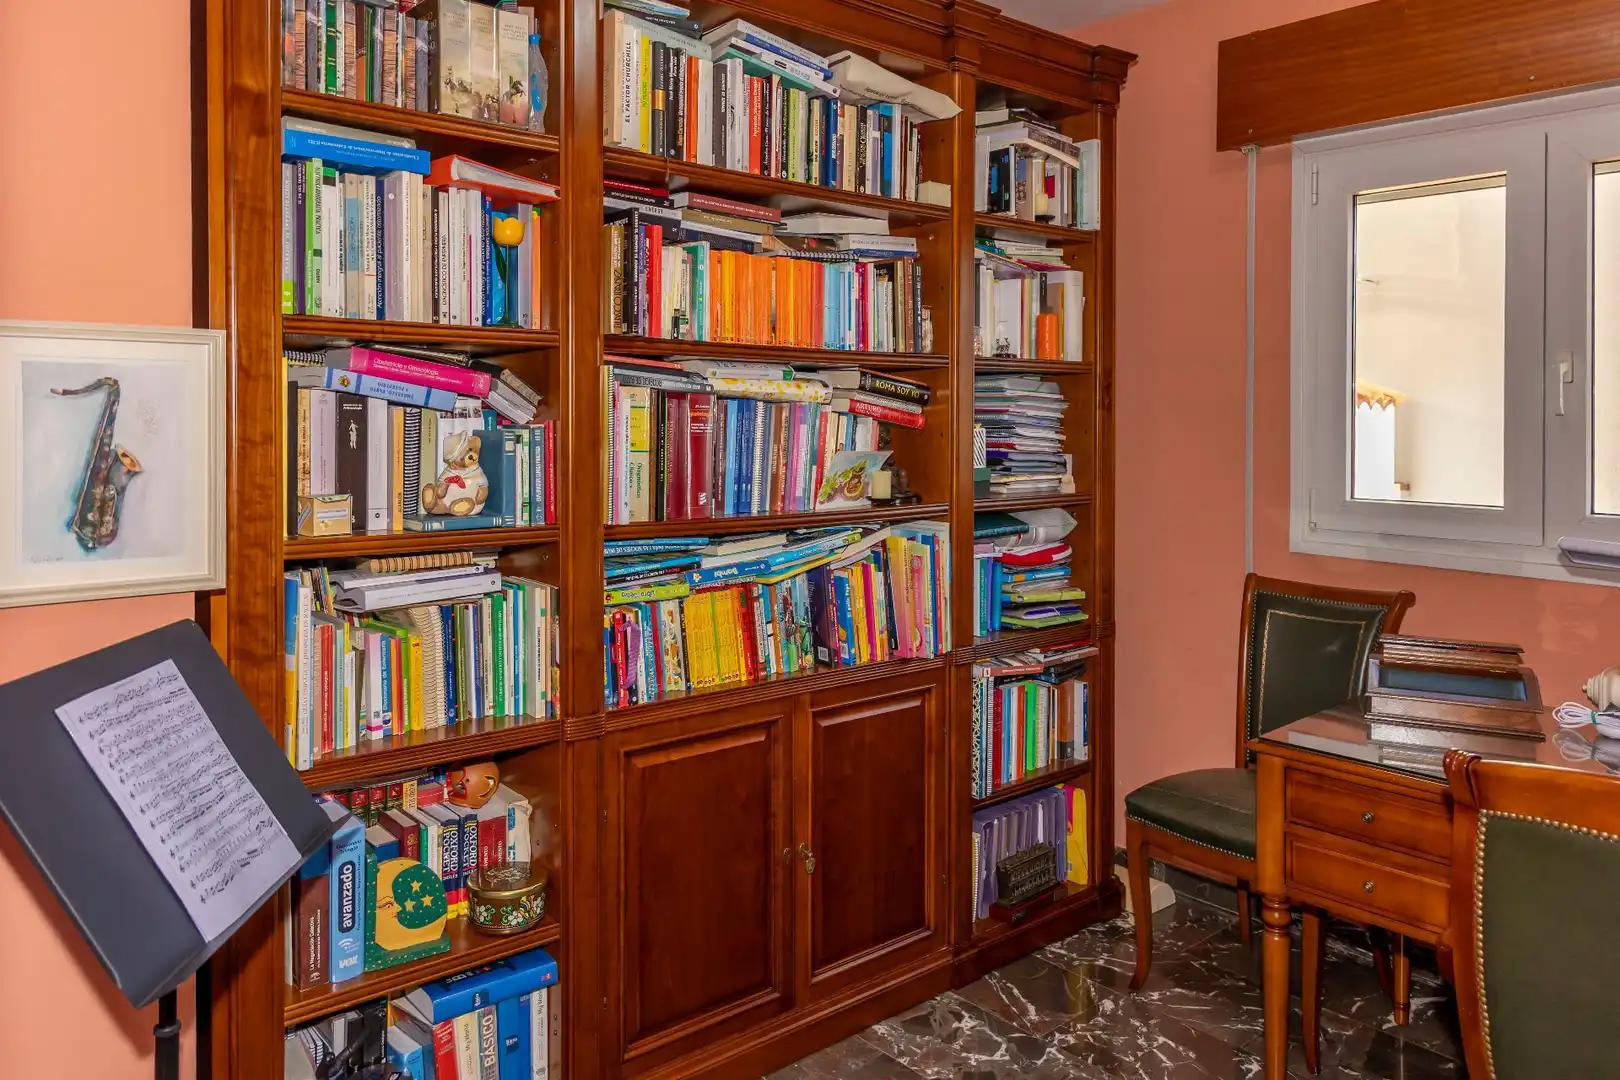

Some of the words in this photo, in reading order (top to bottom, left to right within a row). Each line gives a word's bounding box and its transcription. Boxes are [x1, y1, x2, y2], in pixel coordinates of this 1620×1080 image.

[625, 115, 631, 123] EL
[874, 380, 896, 392] ROMA
[897, 386, 910, 395] SOY
[911, 389, 920, 398] YO
[856, 402, 882, 414] ARTURO
[714, 566, 738, 578] Bambi
[450, 830, 458, 872] OXFORD
[470, 826, 478, 866] OXFORD
[340, 864, 352, 928] avanzado
[339, 955, 358, 968] VOX
[464, 1042, 472, 1052] My
